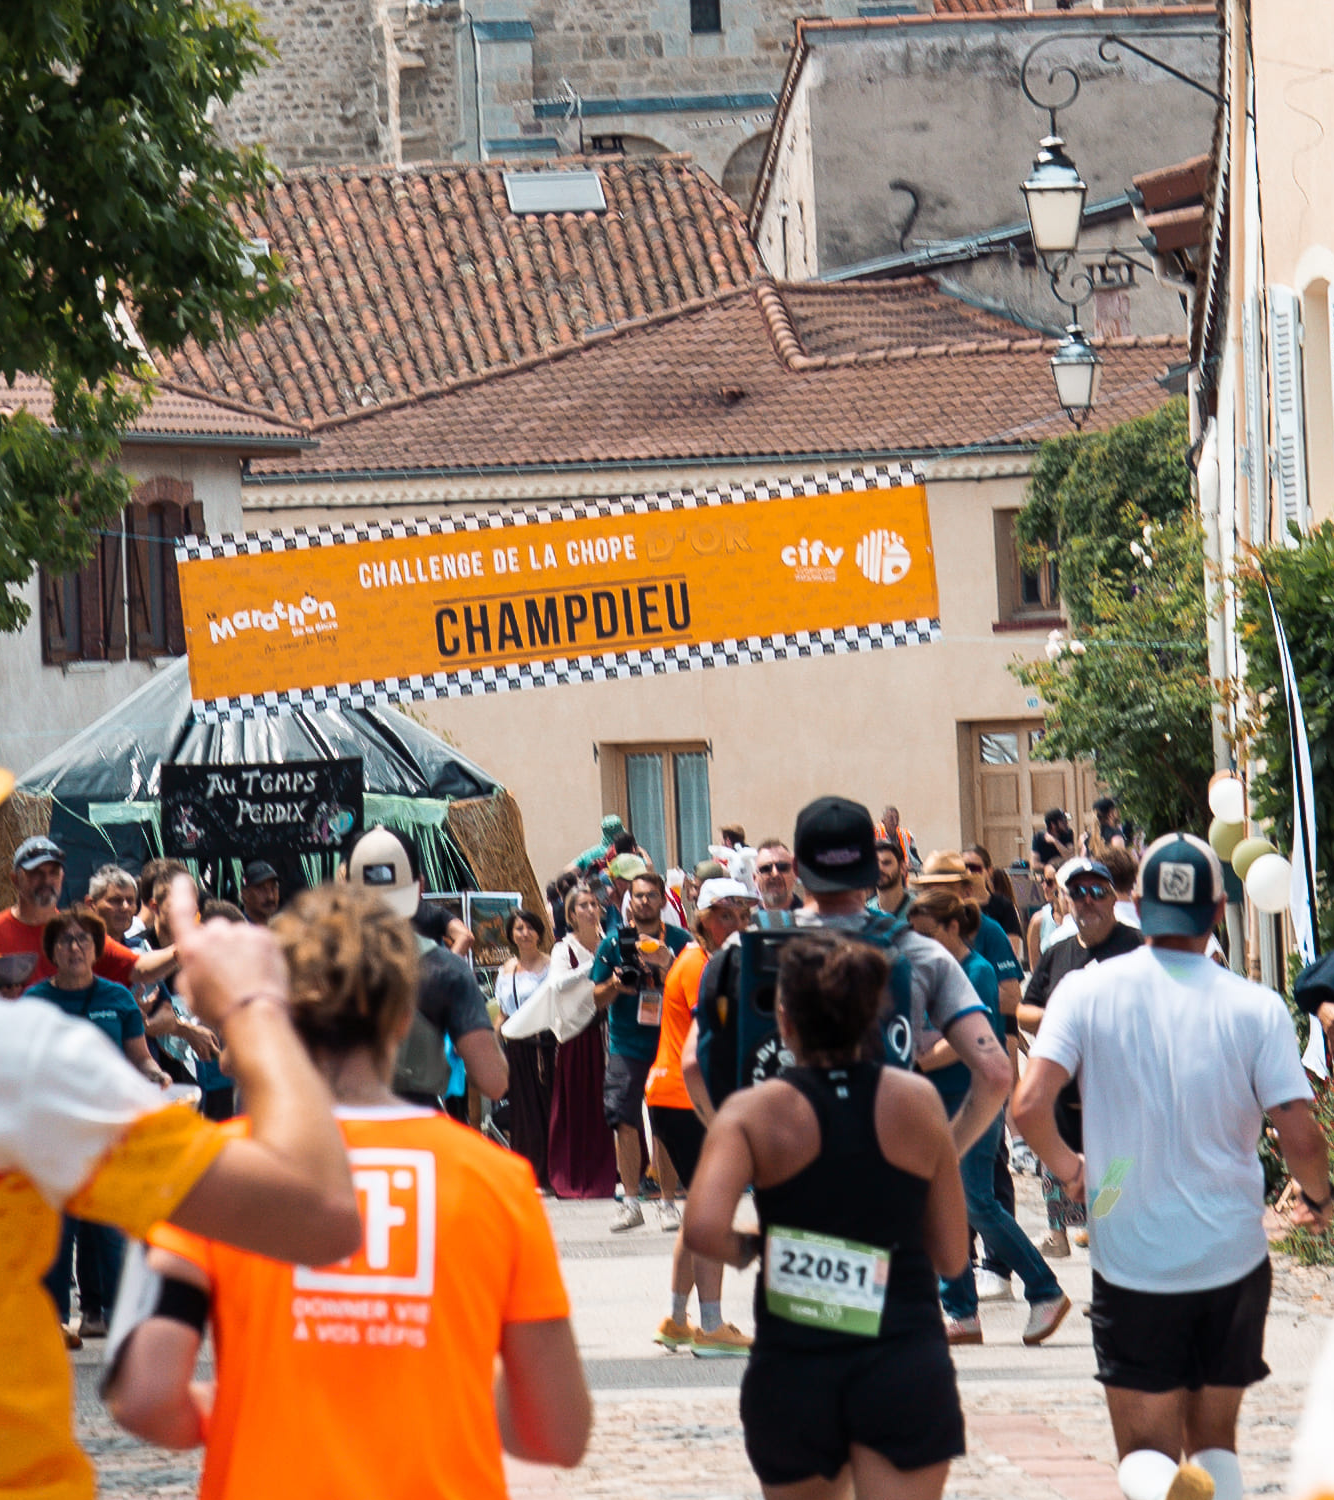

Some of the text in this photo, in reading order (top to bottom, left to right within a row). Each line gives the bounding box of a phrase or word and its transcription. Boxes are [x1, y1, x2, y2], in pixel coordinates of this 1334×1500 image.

[358, 525, 752, 589] CHALLENGE DE LA CHOPE D'OR
[781, 537, 844, 567] cifv
[208, 595, 337, 644] Marathon
[434, 582, 691, 657] CHAMPDIEU
[779, 1250, 869, 1288] 22051
[292, 1297, 431, 1323] DONNER VIE
[315, 1323, 360, 1343] VOS
